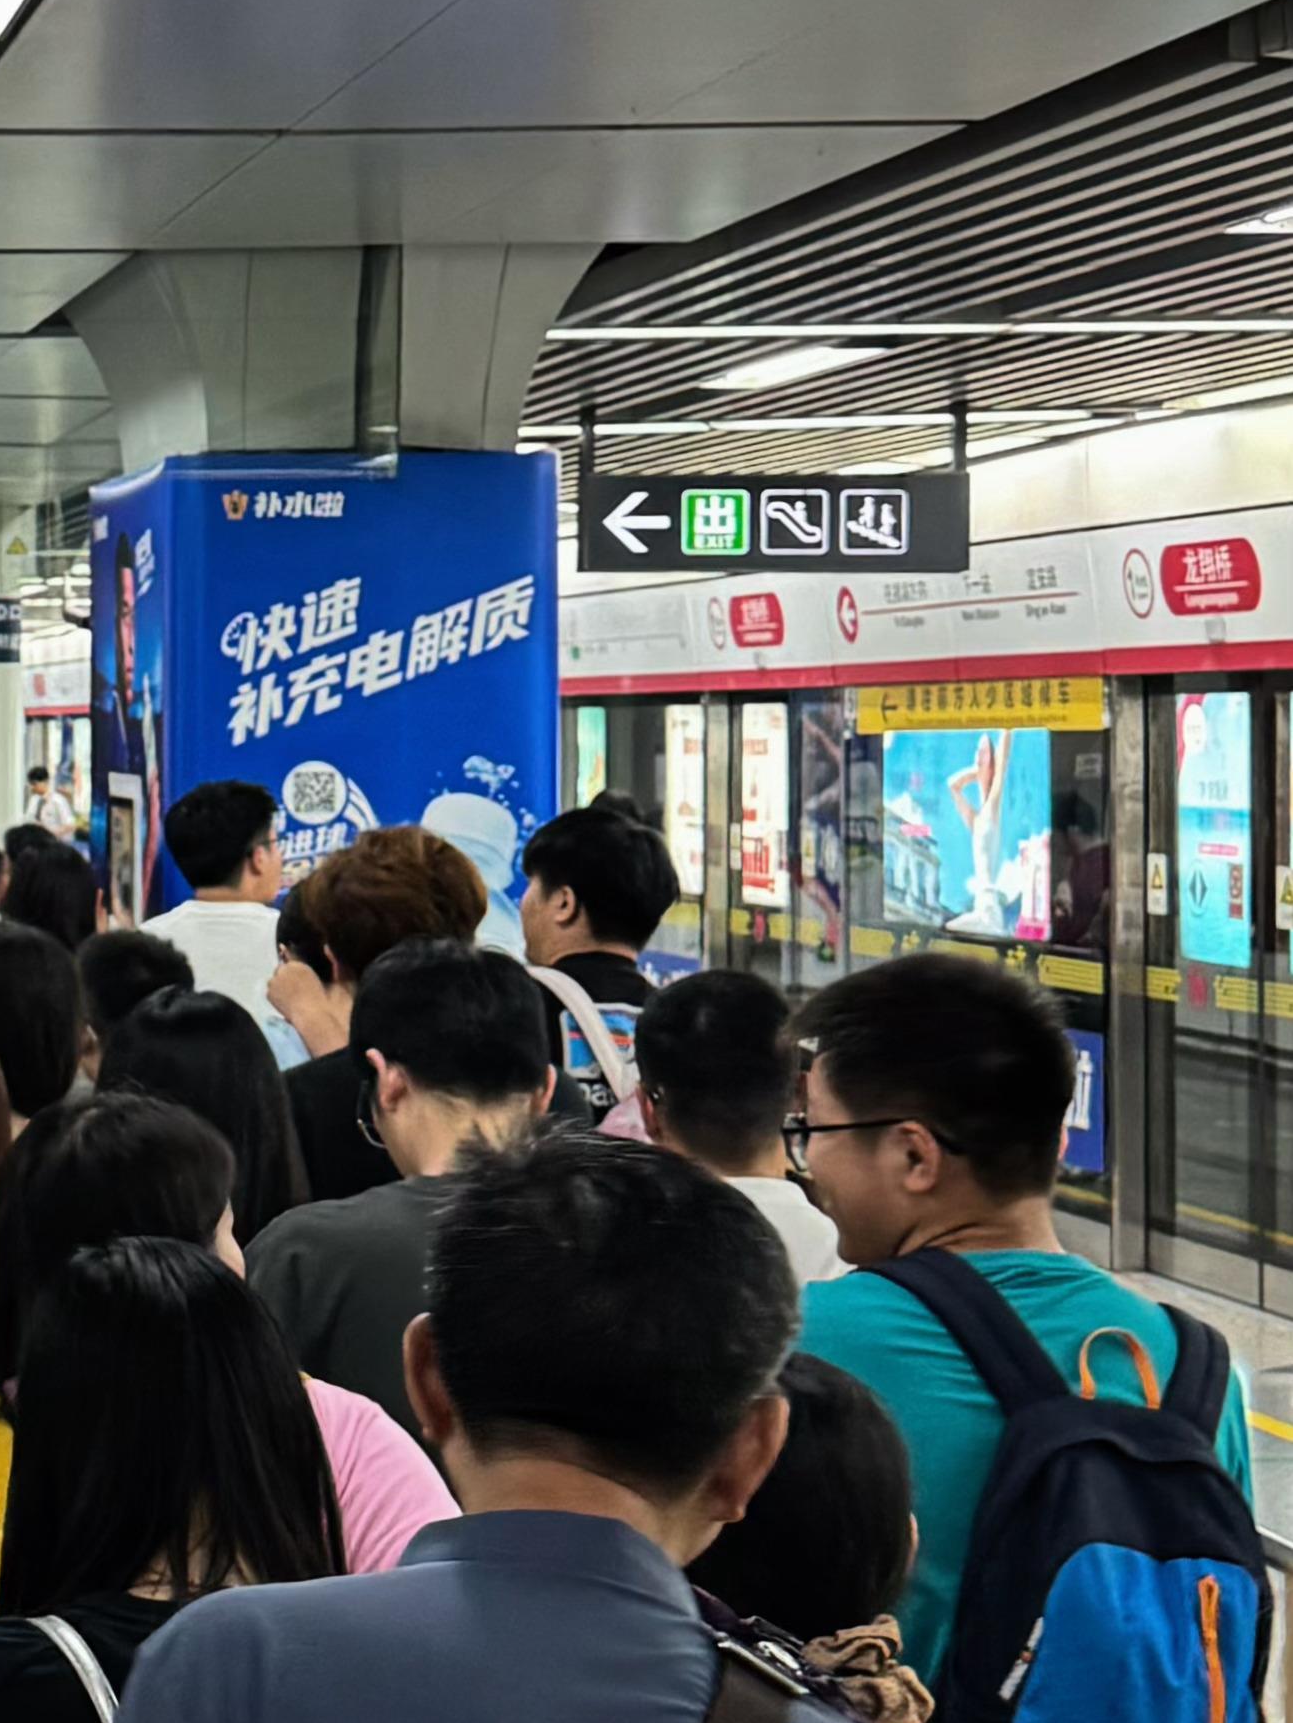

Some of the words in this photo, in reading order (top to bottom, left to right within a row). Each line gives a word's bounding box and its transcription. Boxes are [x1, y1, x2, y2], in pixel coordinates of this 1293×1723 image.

[254, 491, 345, 518] 补水啦
[694, 495, 737, 533] 出
[694, 535, 736, 548] EXIT
[220, 576, 362, 676] 快速
[227, 575, 535, 747] 补充电解质
